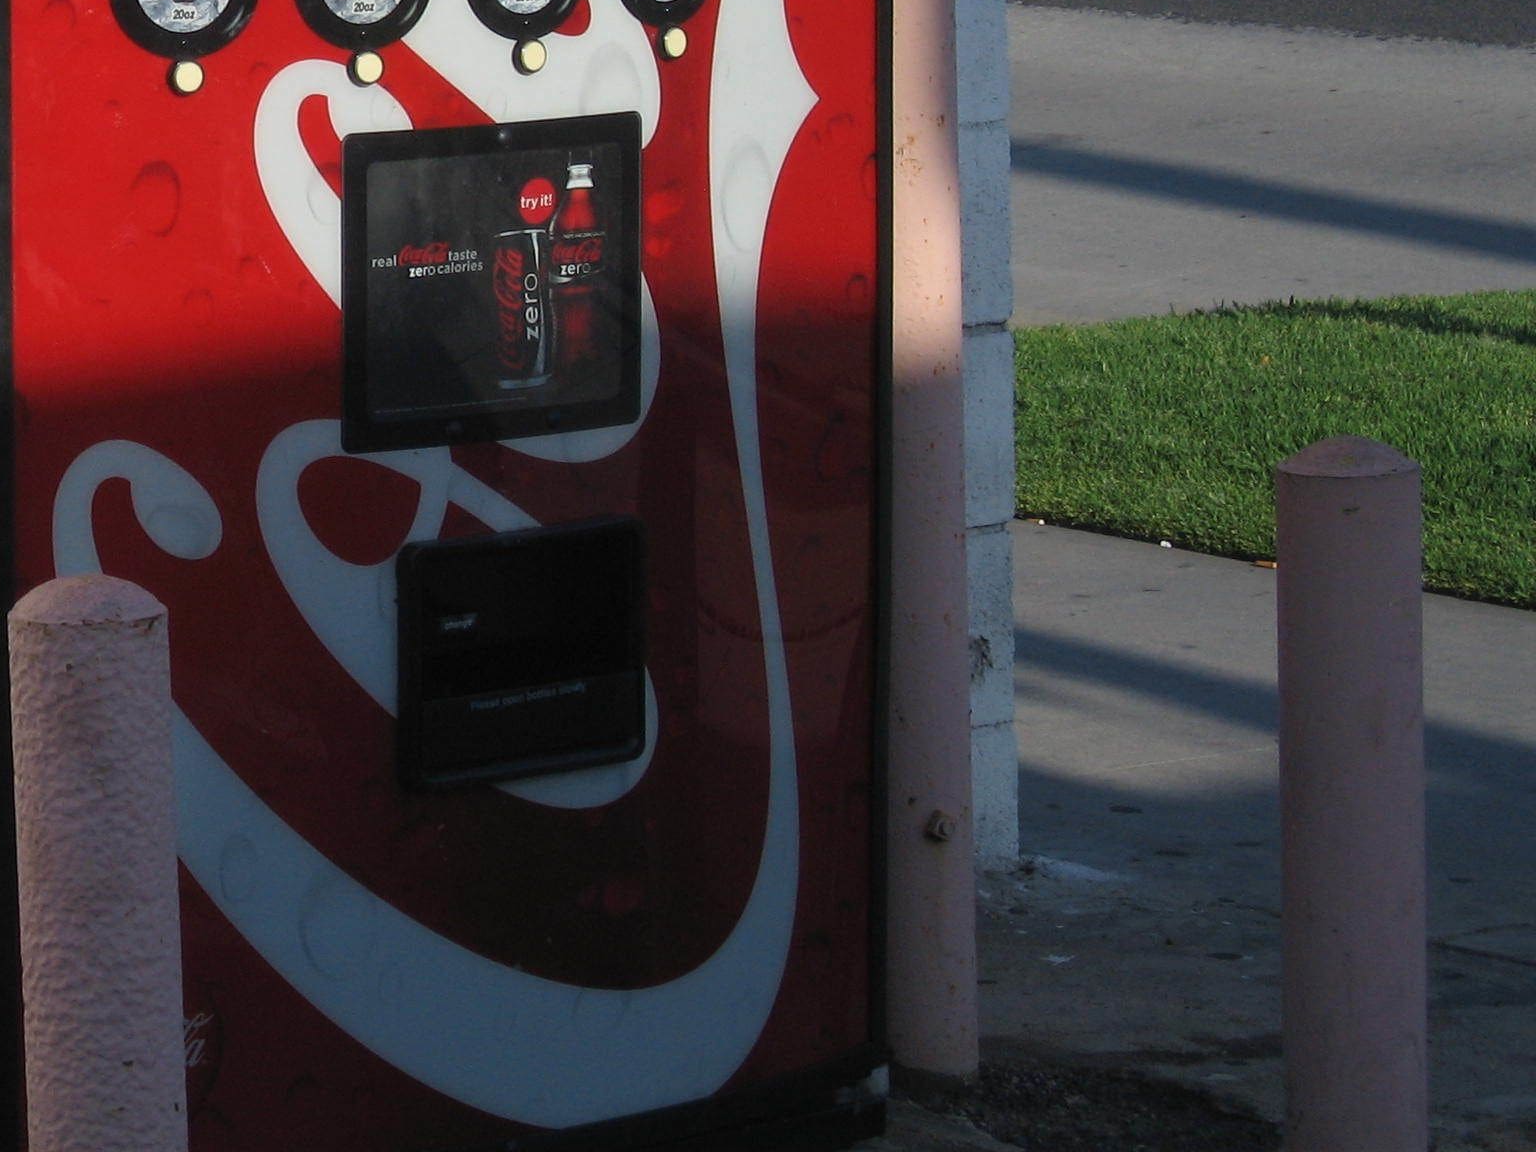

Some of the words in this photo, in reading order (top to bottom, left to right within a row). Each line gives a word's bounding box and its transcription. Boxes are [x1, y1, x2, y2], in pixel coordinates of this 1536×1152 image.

[172, 7, 196, 20] 20oz
[353, 1, 375, 14] 20oz
[520, 195, 539, 210] try
[540, 193, 553, 207] it!
[371, 254, 397, 268] real
[448, 250, 478, 262] taste
[408, 265, 436, 278] zero
[437, 261, 484, 275] calories
[560, 262, 592, 276] zero
[524, 272, 540, 341] zero
